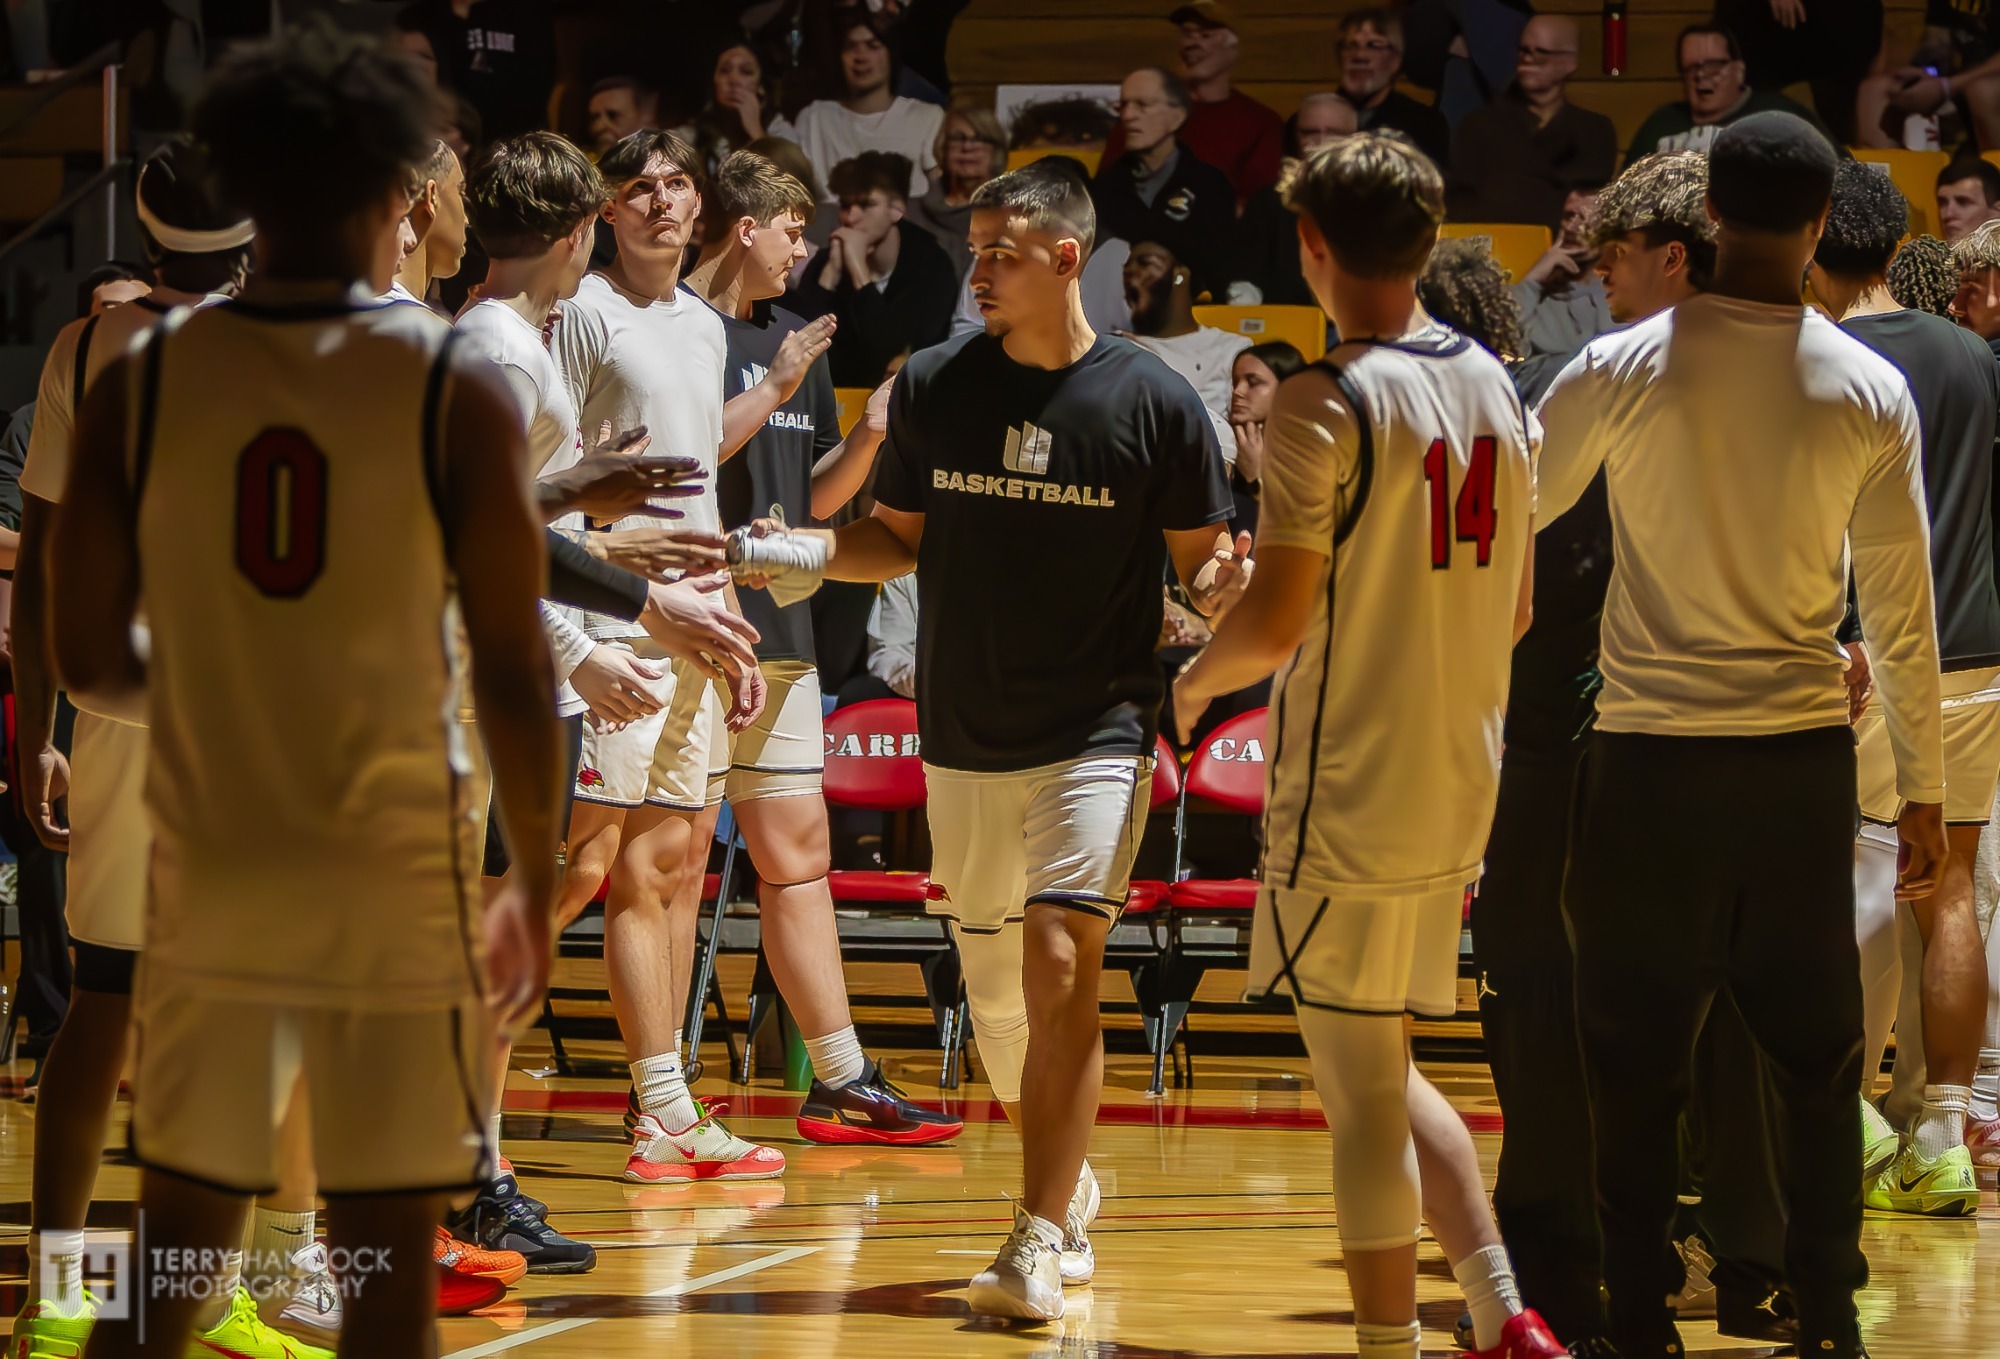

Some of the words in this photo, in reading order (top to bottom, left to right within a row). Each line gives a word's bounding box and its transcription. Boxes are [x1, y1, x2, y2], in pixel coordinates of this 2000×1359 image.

[236, 425, 328, 599] 0
[933, 468, 1116, 507] BASKETBALL
[1424, 435, 1498, 570] 14
